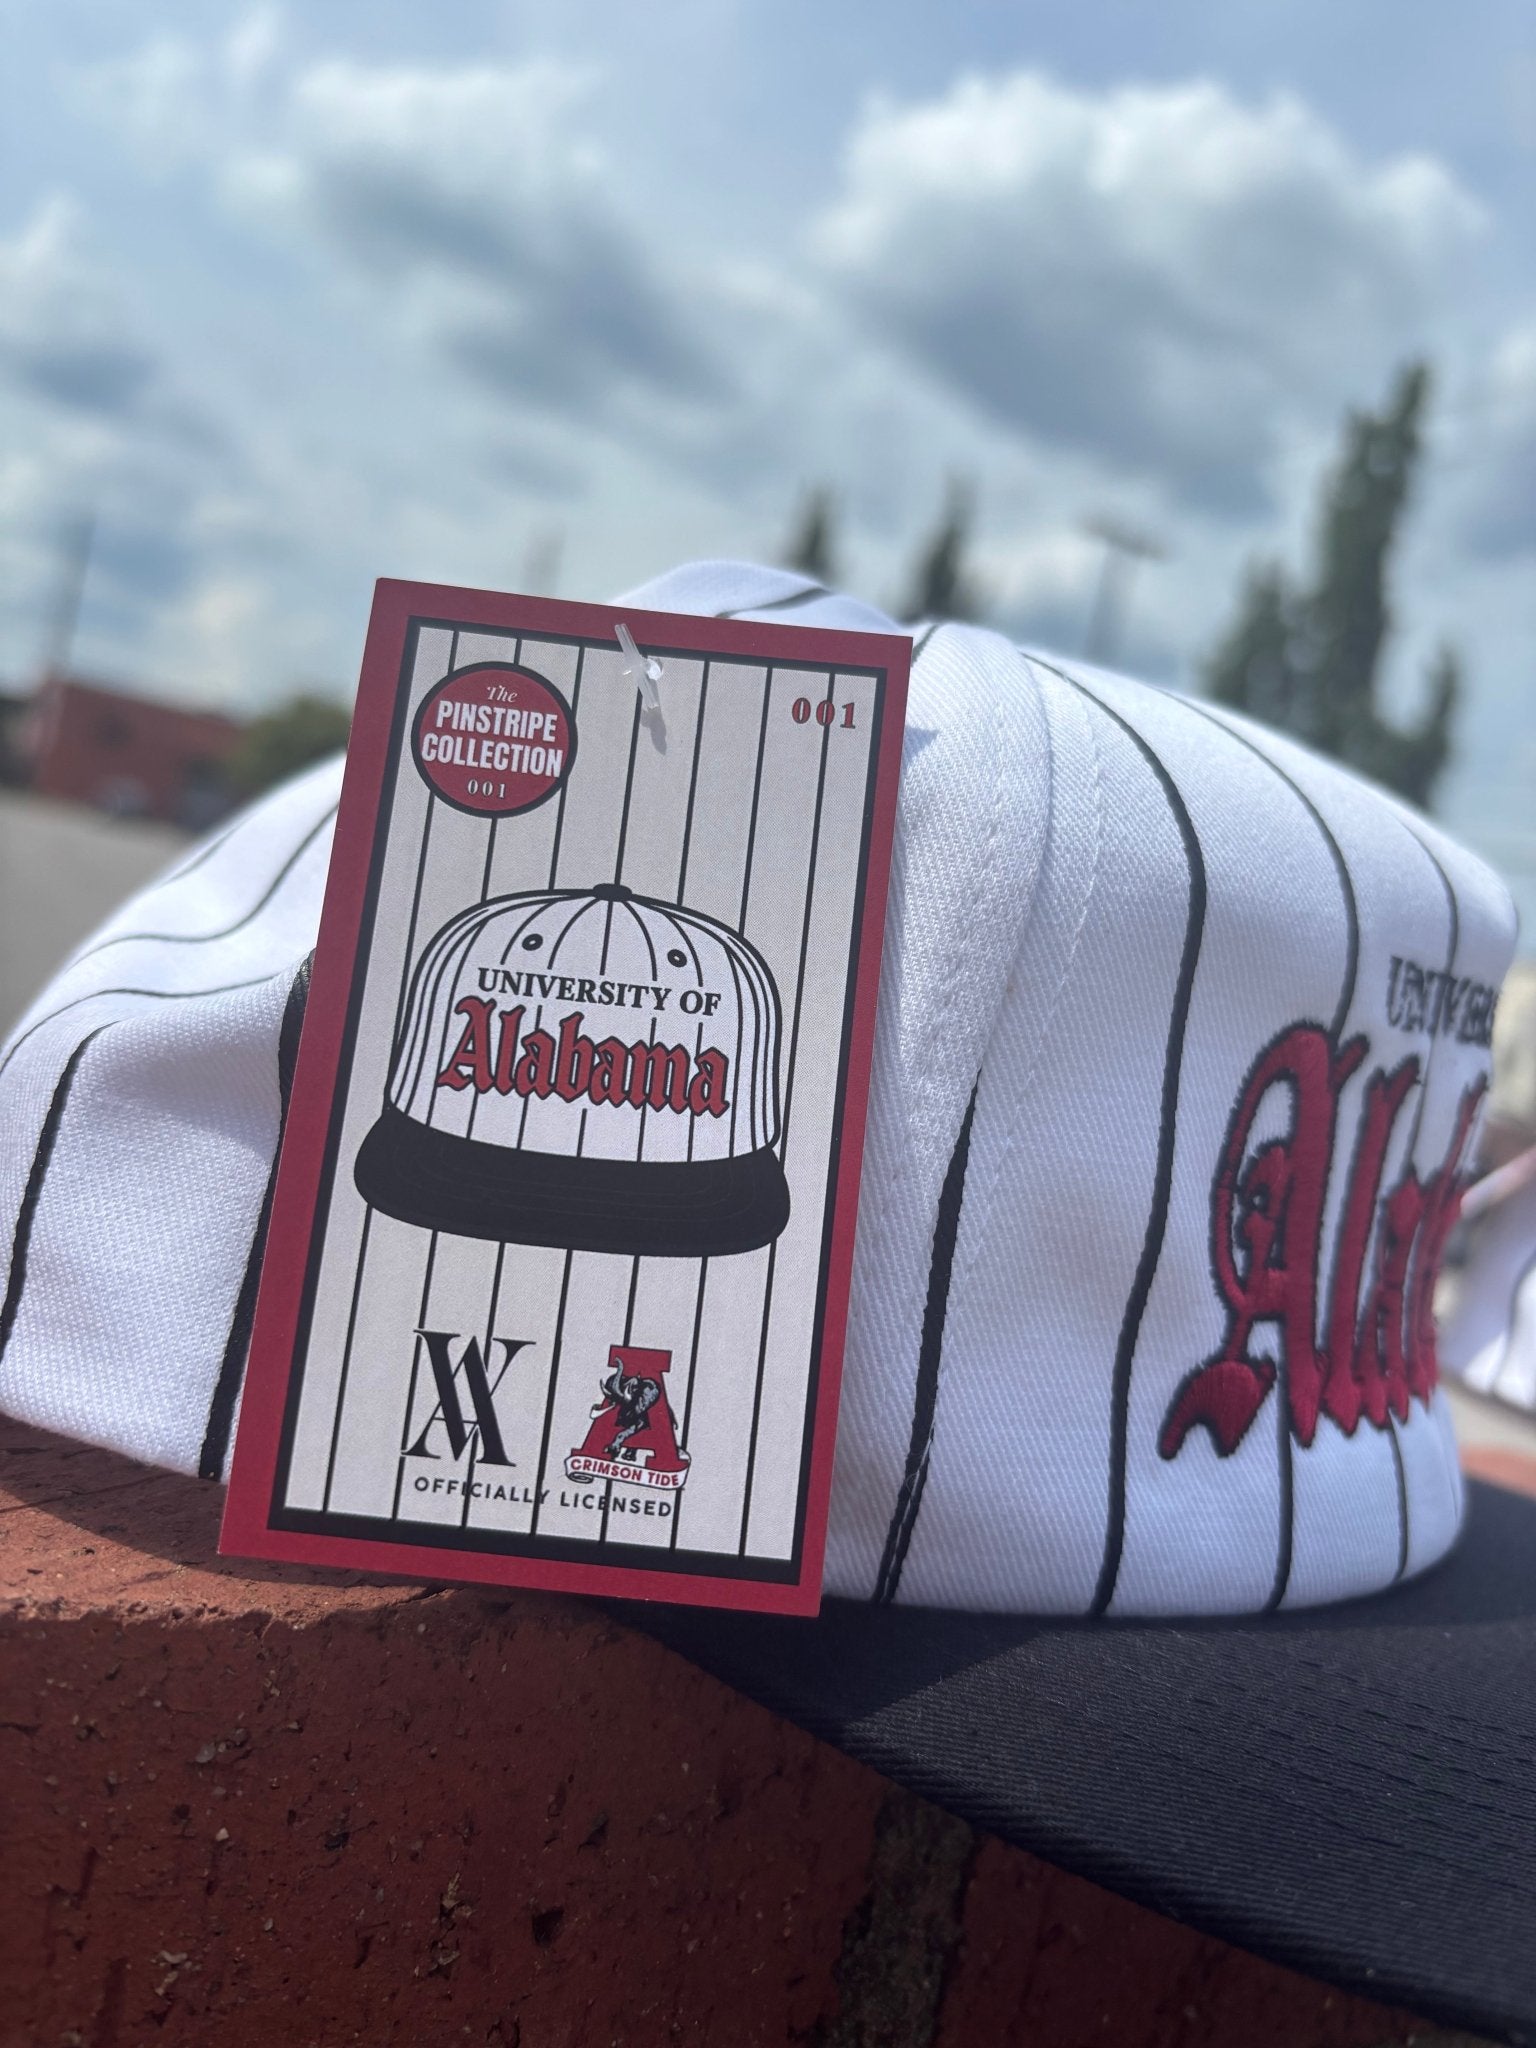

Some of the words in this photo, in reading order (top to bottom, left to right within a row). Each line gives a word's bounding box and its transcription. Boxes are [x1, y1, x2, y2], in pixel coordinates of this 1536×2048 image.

[487, 685, 518, 703] The
[791, 697, 857, 729] 001
[436, 700, 558, 742] PINSTRIPE
[421, 733, 563, 777] COLLECTION
[467, 779, 507, 798] 001
[478, 967, 672, 1011] UNIVERSITY
[679, 990, 722, 1016] OF
[437, 995, 730, 1119] Alabama
[571, 1459, 642, 1481] CRIMSON
[648, 1472, 679, 1486] TIDE
[414, 1476, 550, 1505] OFFICIALLY
[560, 1491, 672, 1517] LICENSED
